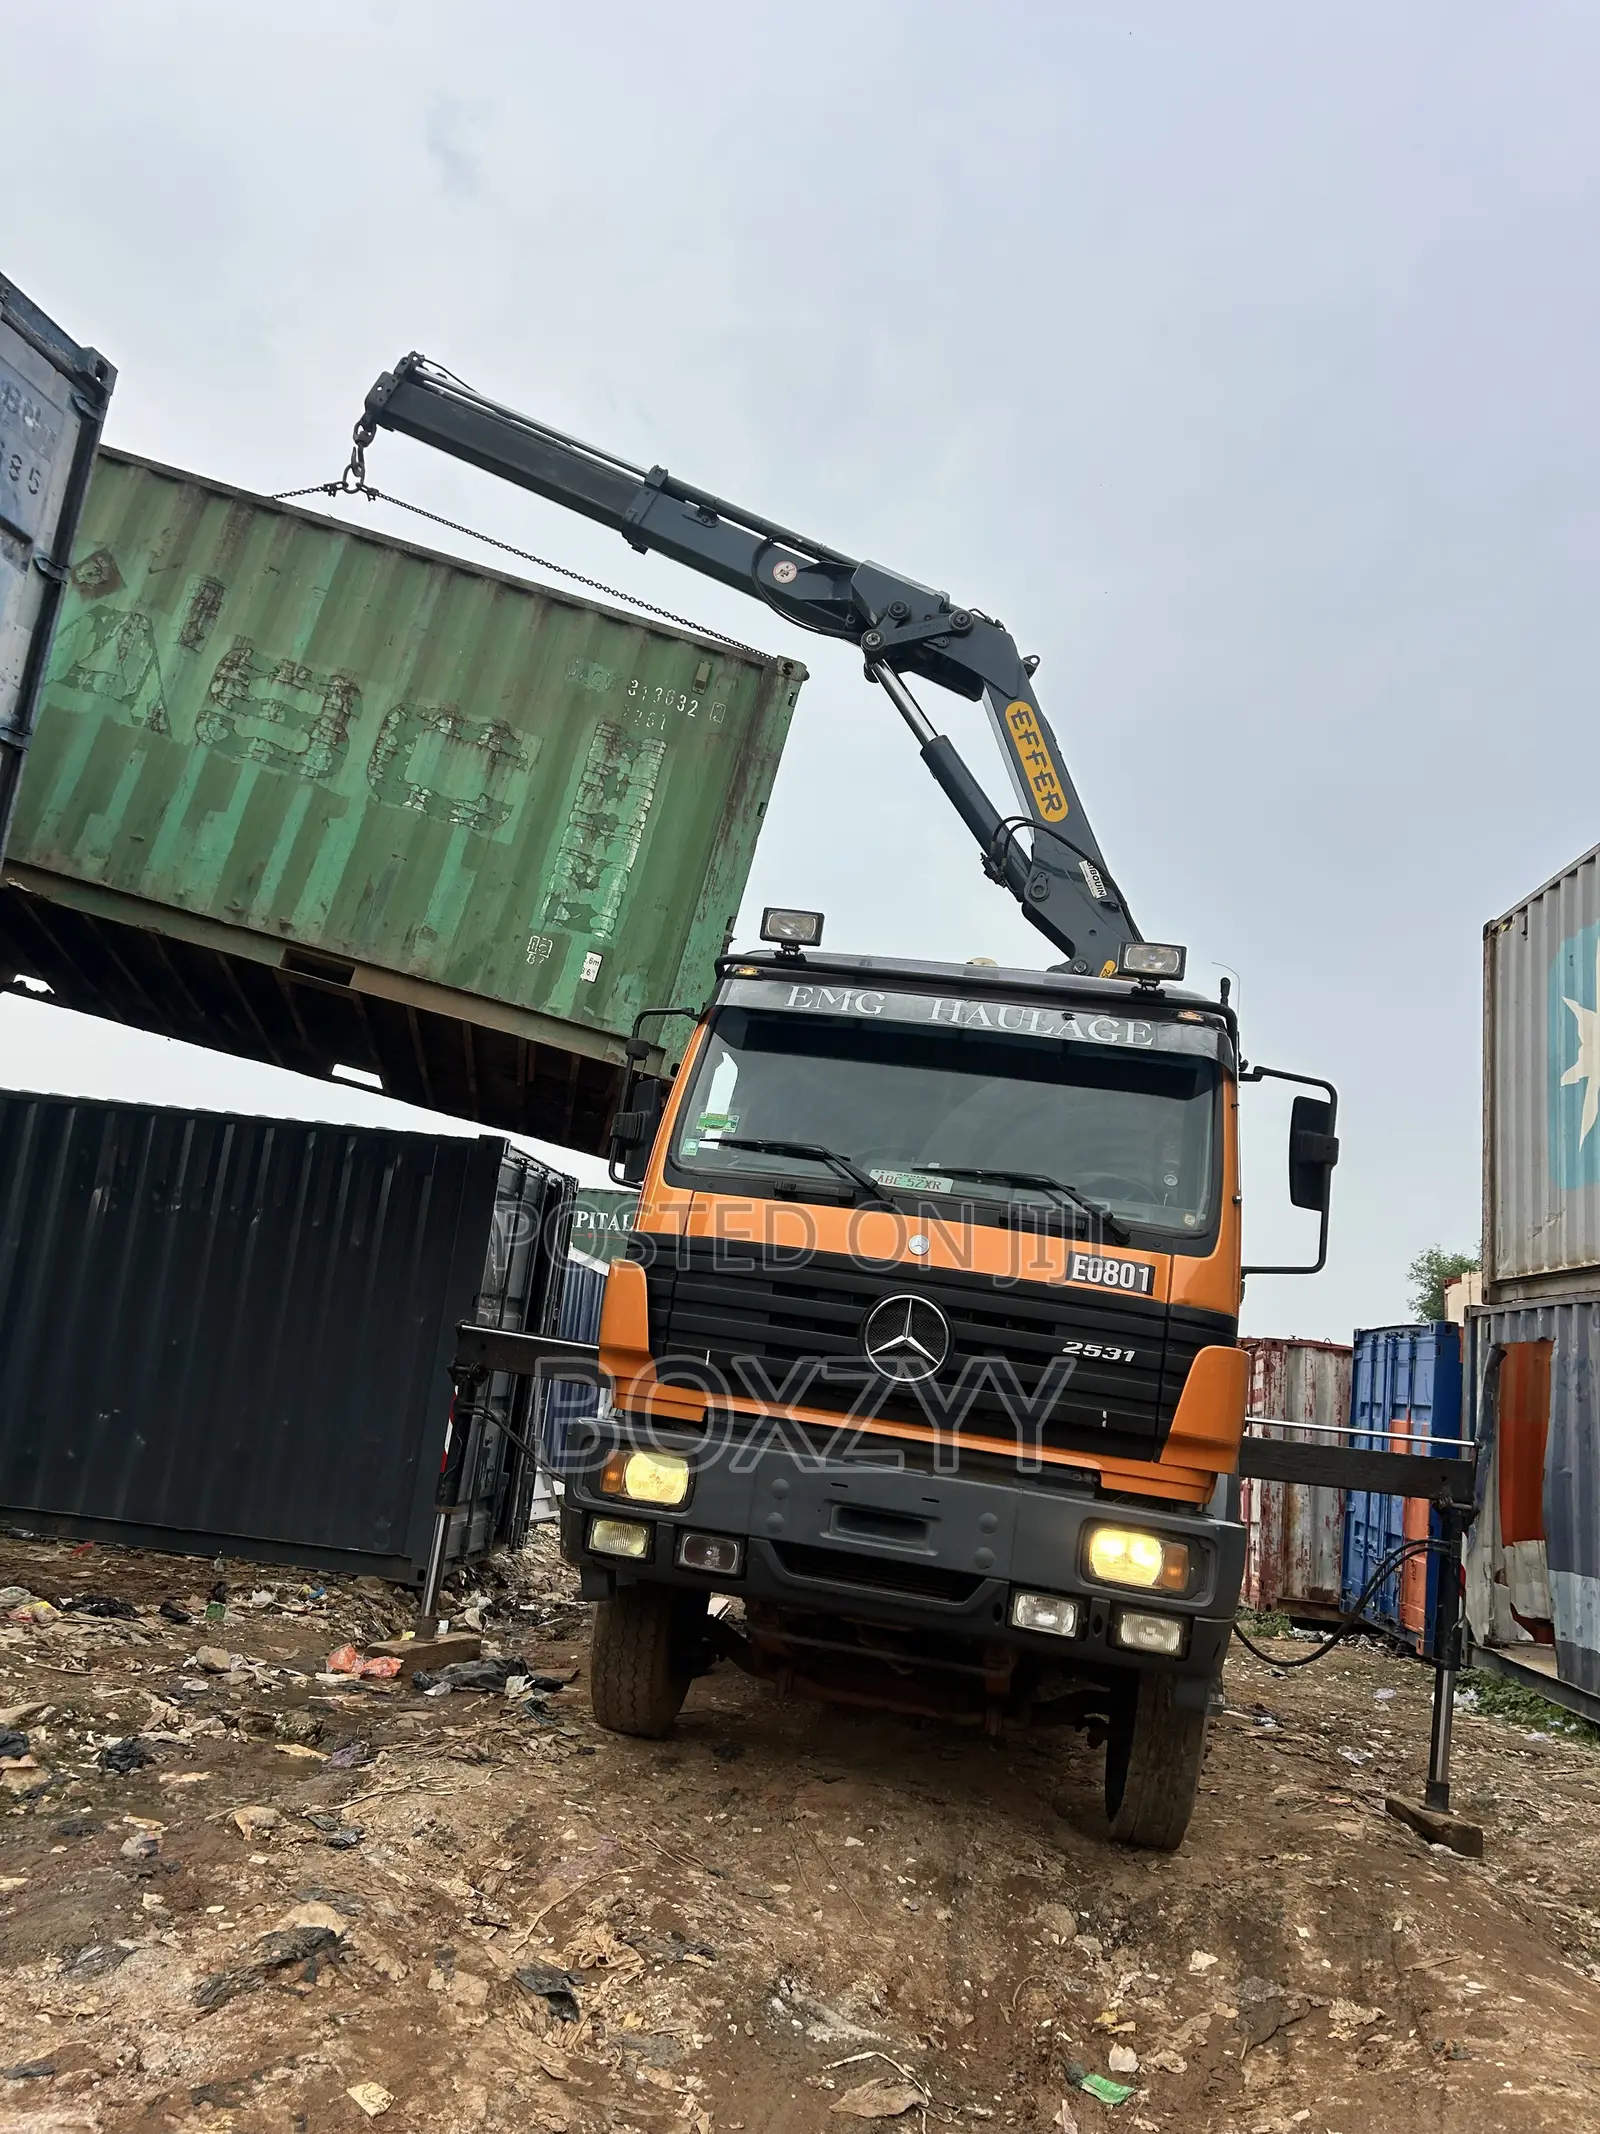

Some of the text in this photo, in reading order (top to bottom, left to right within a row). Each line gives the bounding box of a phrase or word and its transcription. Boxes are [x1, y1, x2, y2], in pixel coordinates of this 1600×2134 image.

[1010, 708, 1063, 814] EFFER
[784, 985, 1154, 1046] EMG HAULAGE
[1072, 1254, 1150, 1293] E0801
[1062, 1341, 1136, 1362] 2531
